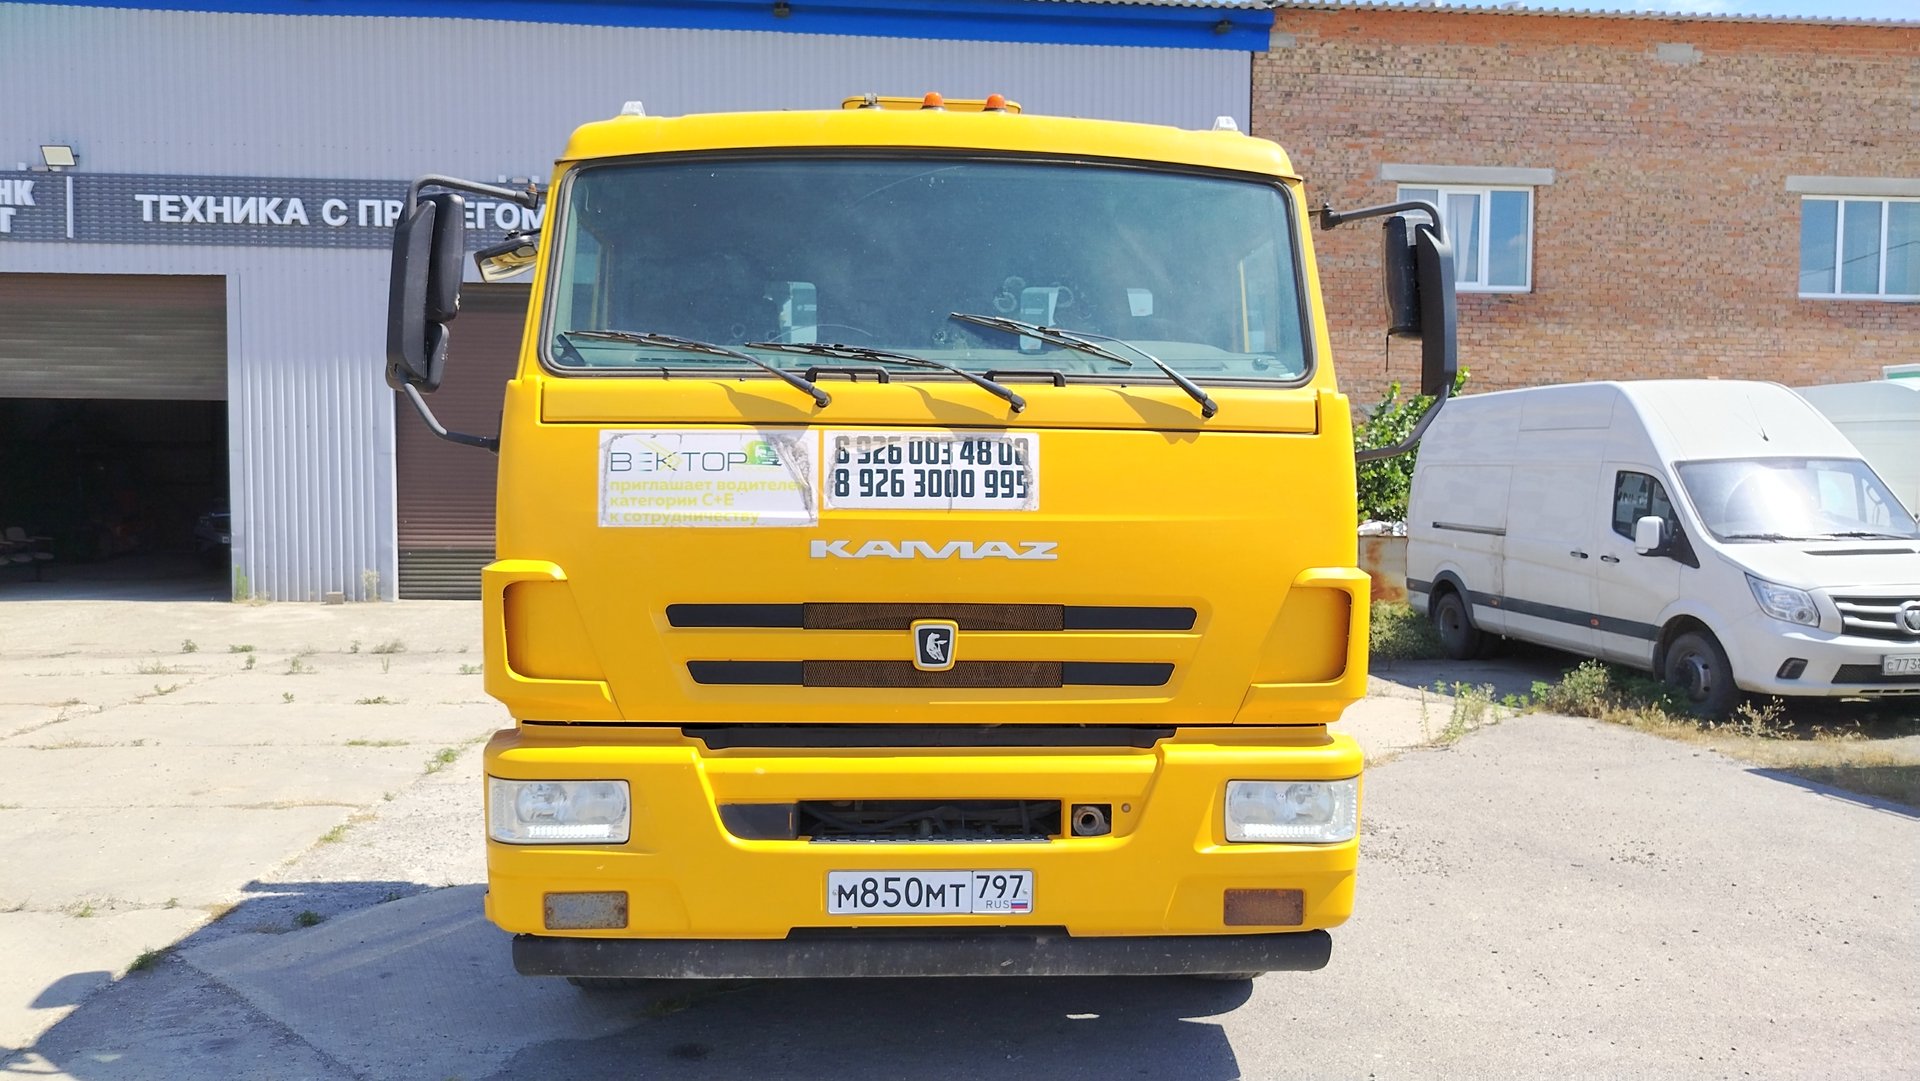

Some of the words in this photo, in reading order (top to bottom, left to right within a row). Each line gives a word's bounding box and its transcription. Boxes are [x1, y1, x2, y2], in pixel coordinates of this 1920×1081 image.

[134, 194, 310, 225] ТЕХНИКА
[322, 199, 348, 227] С
[358, 199, 547, 230] ПРЕГОМ
[835, 435, 850, 464] 8
[857, 435, 902, 464] 926
[908, 436, 951, 465] 003
[959, 437, 992, 466] 48
[610, 451, 748, 472] ВЕКТОР
[609, 480, 712, 495] приглашает
[834, 468, 850, 498] 8
[859, 469, 905, 498] 926
[913, 469, 975, 498] 3000
[984, 469, 1027, 499] 995
[609, 496, 698, 510] категории
[609, 513, 619, 522] к
[623, 511, 759, 526] сотрудничеству
[810, 540, 1058, 560] KAMAZ
[837, 877, 966, 908] М850МТ
[976, 874, 1024, 899] 797
[986, 900, 1010, 909] RUS
